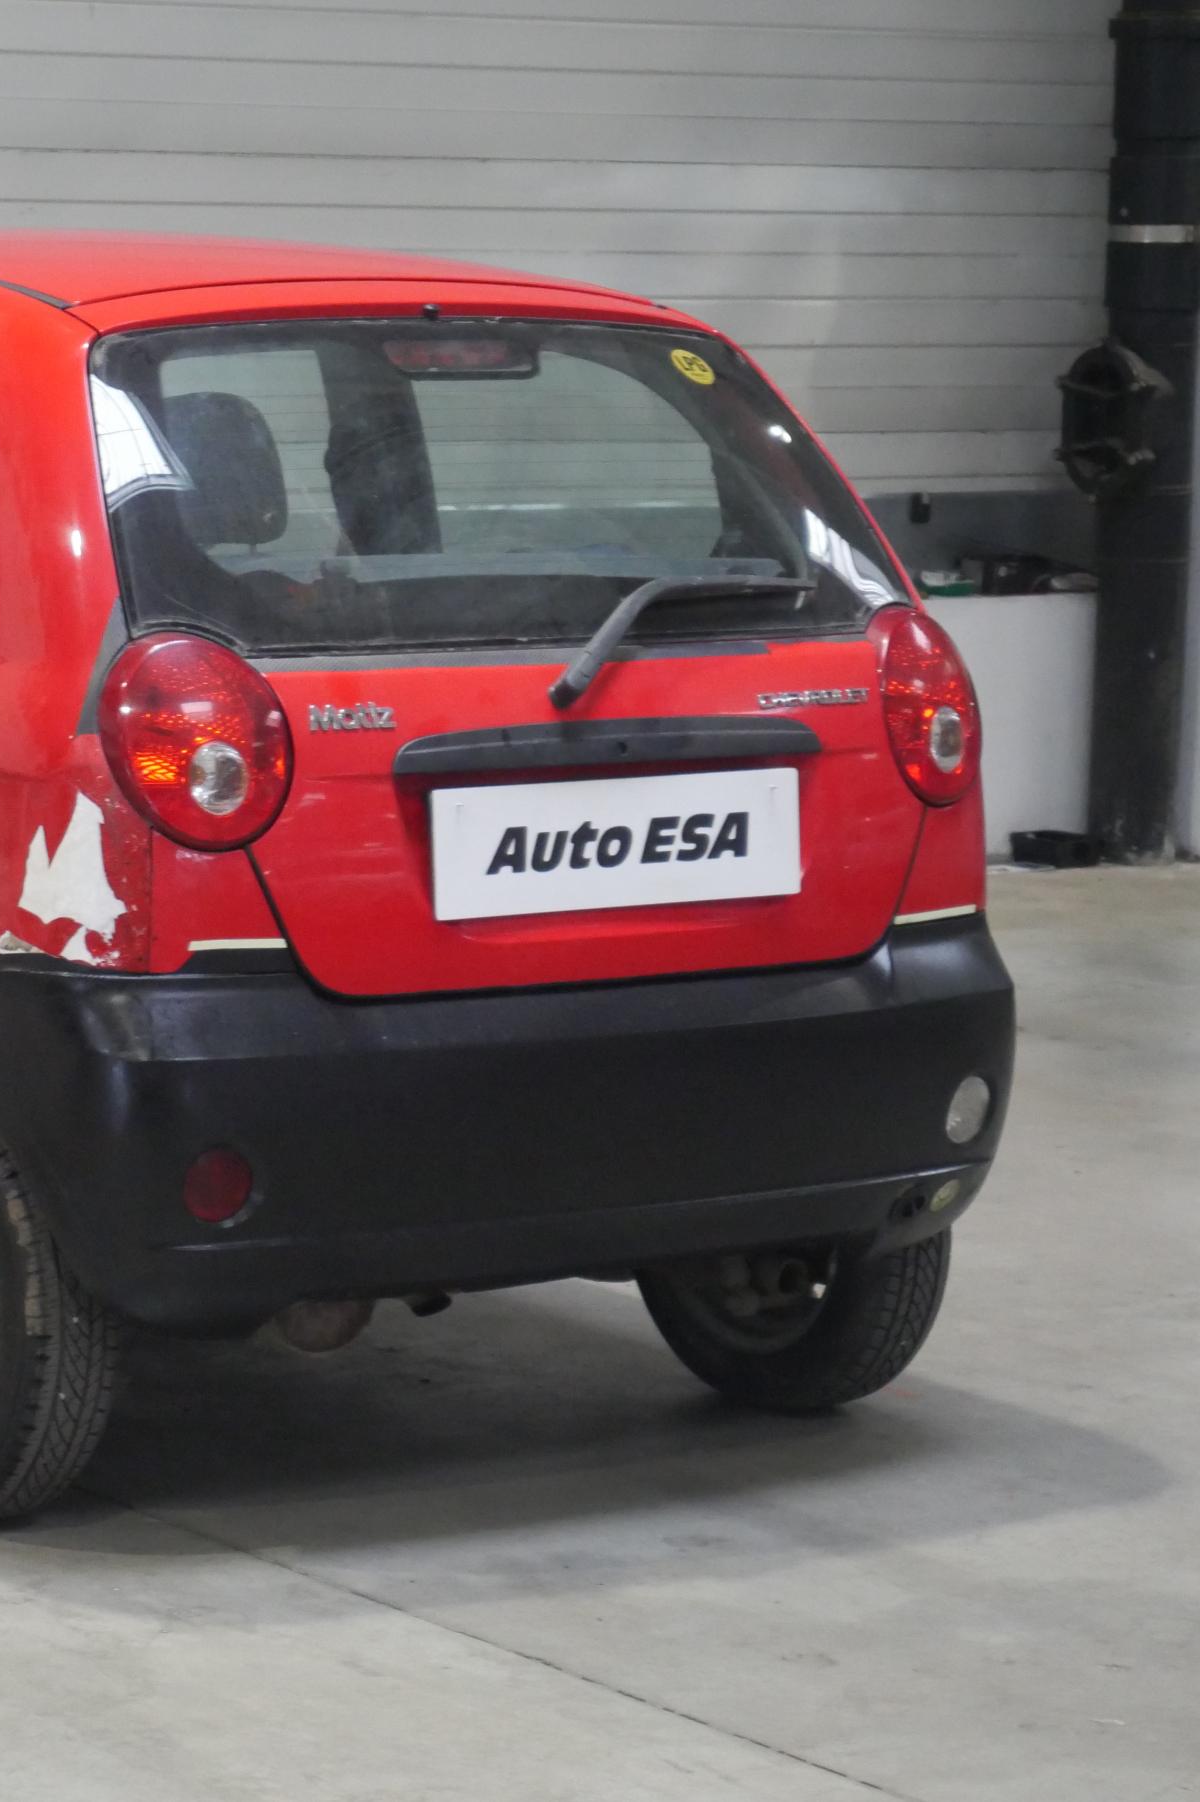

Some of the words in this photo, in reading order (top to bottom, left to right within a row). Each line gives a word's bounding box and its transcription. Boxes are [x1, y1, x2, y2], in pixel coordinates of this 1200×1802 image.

[673, 354, 710, 373] LPG
[757, 687, 870, 709] CHEVROLET
[308, 701, 397, 732] Matiz
[486, 821, 633, 875] Auto
[640, 811, 750, 864] ESA
